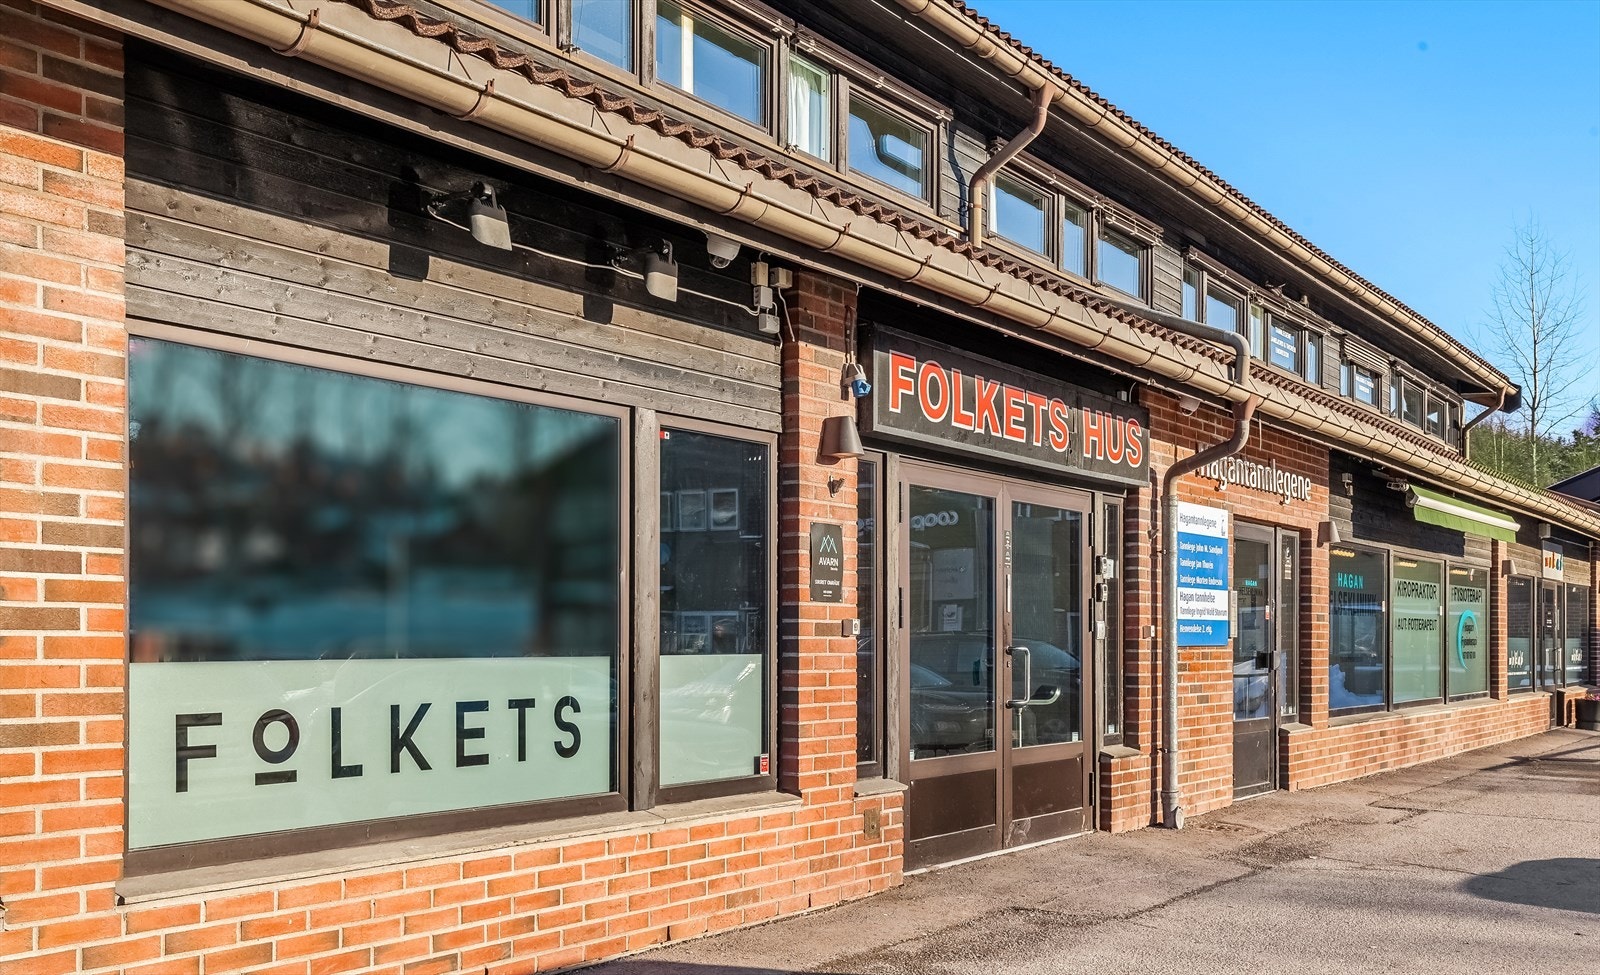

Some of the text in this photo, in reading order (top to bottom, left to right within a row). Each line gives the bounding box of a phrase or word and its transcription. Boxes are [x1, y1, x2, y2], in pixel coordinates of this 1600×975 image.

[888, 348, 1143, 468] FOLKETS HUS
[1179, 512, 1217, 530] Hagantannlegene
[818, 556, 839, 567] AVARN
[1337, 572, 1364, 590] HAGAN
[1397, 580, 1437, 600] KIROPRAKTOR
[1179, 591, 1194, 605] Hagan
[1454, 587, 1483, 603] FYSIOTERAPI
[174, 695, 582, 793] FOLKETS
